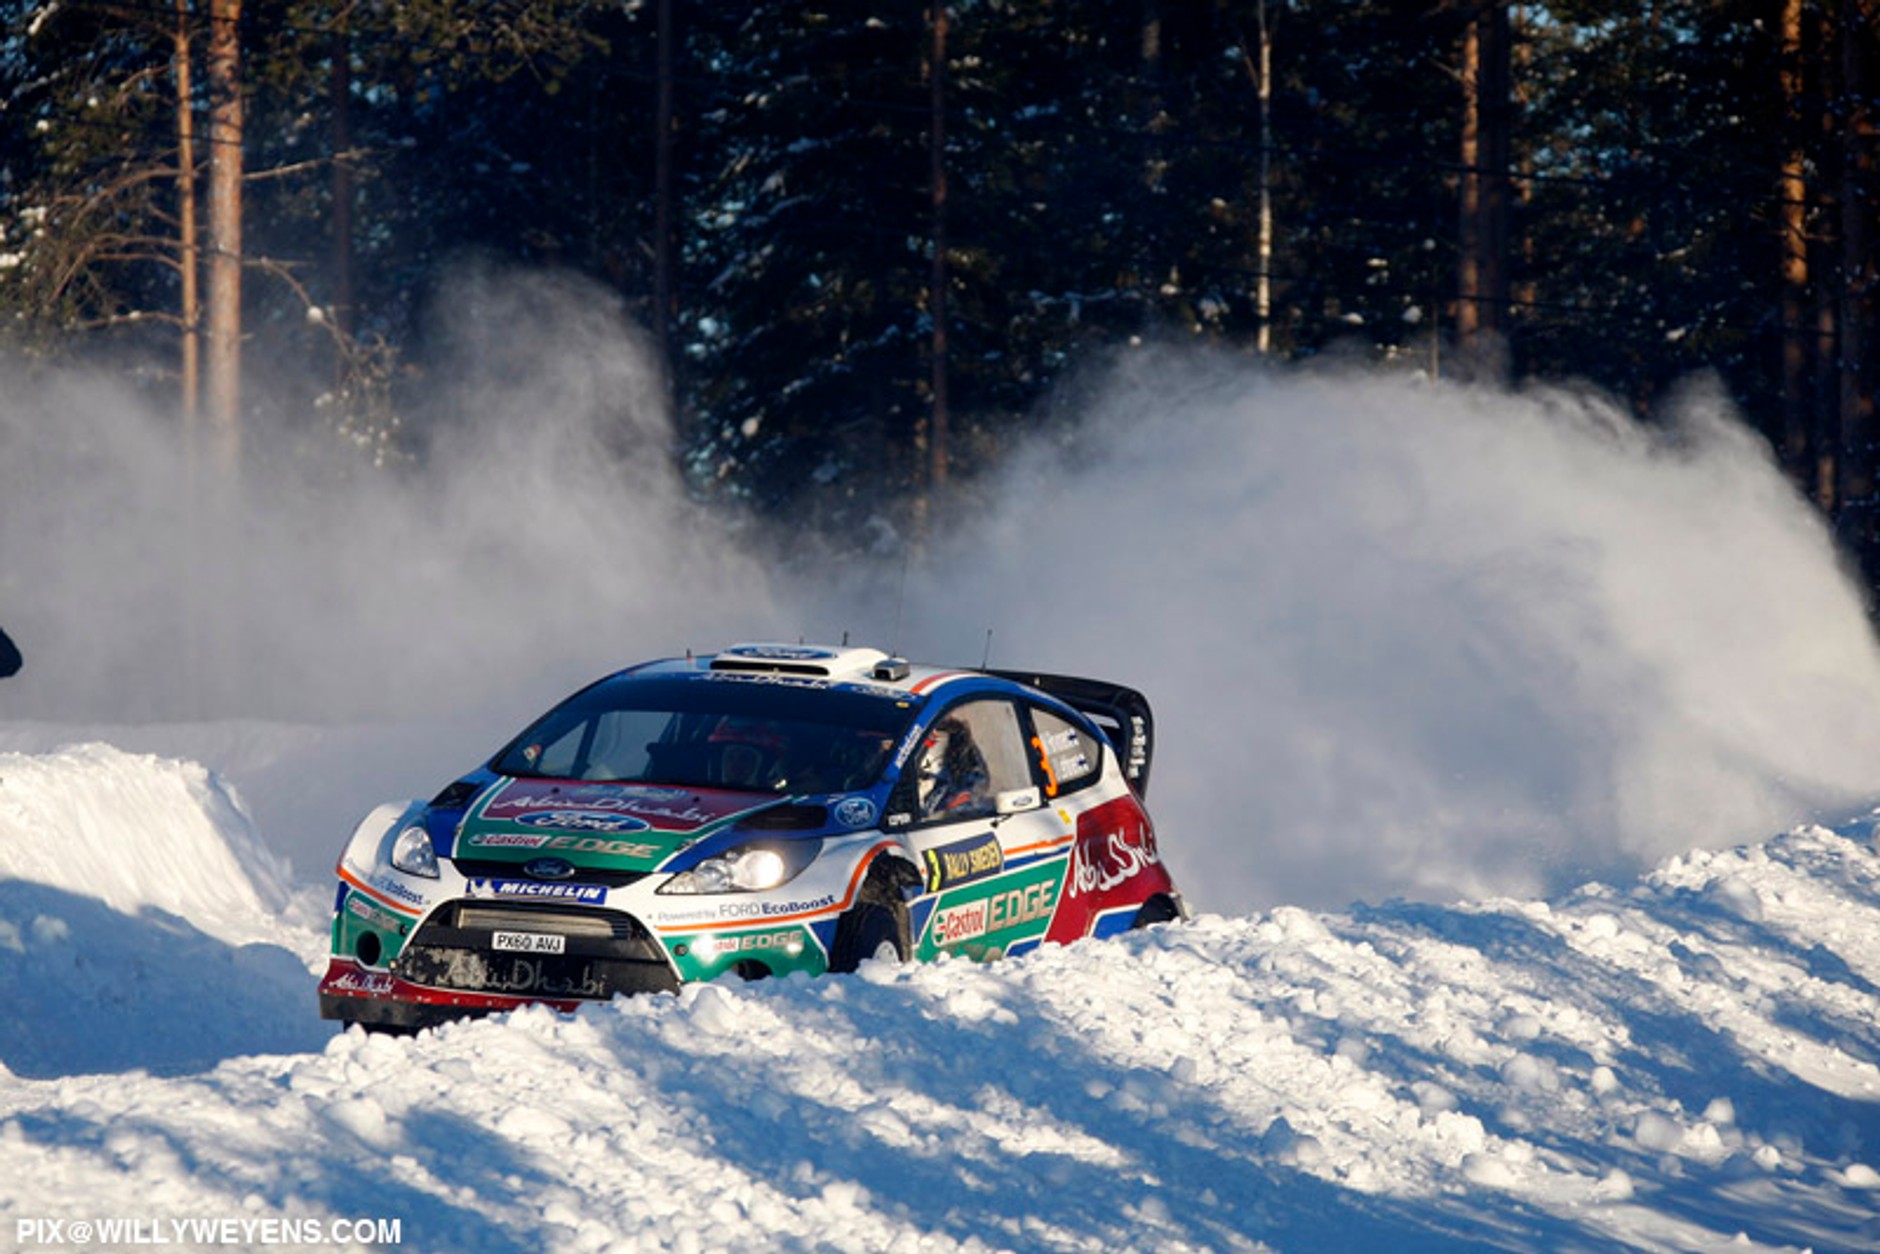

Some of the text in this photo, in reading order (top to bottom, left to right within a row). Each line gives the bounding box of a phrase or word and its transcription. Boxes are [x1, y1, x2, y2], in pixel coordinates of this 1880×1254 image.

[534, 811, 628, 831] Ford
[484, 835, 662, 858] Castrol EDGE
[499, 881, 601, 899] MICHELIN
[719, 903, 760, 917] FORD
[761, 895, 835, 914] EcoBoost
[945, 879, 1056, 940] Castrol EDGE
[536, 937, 562, 951] AVJ
[503, 958, 607, 995] Dhabi
